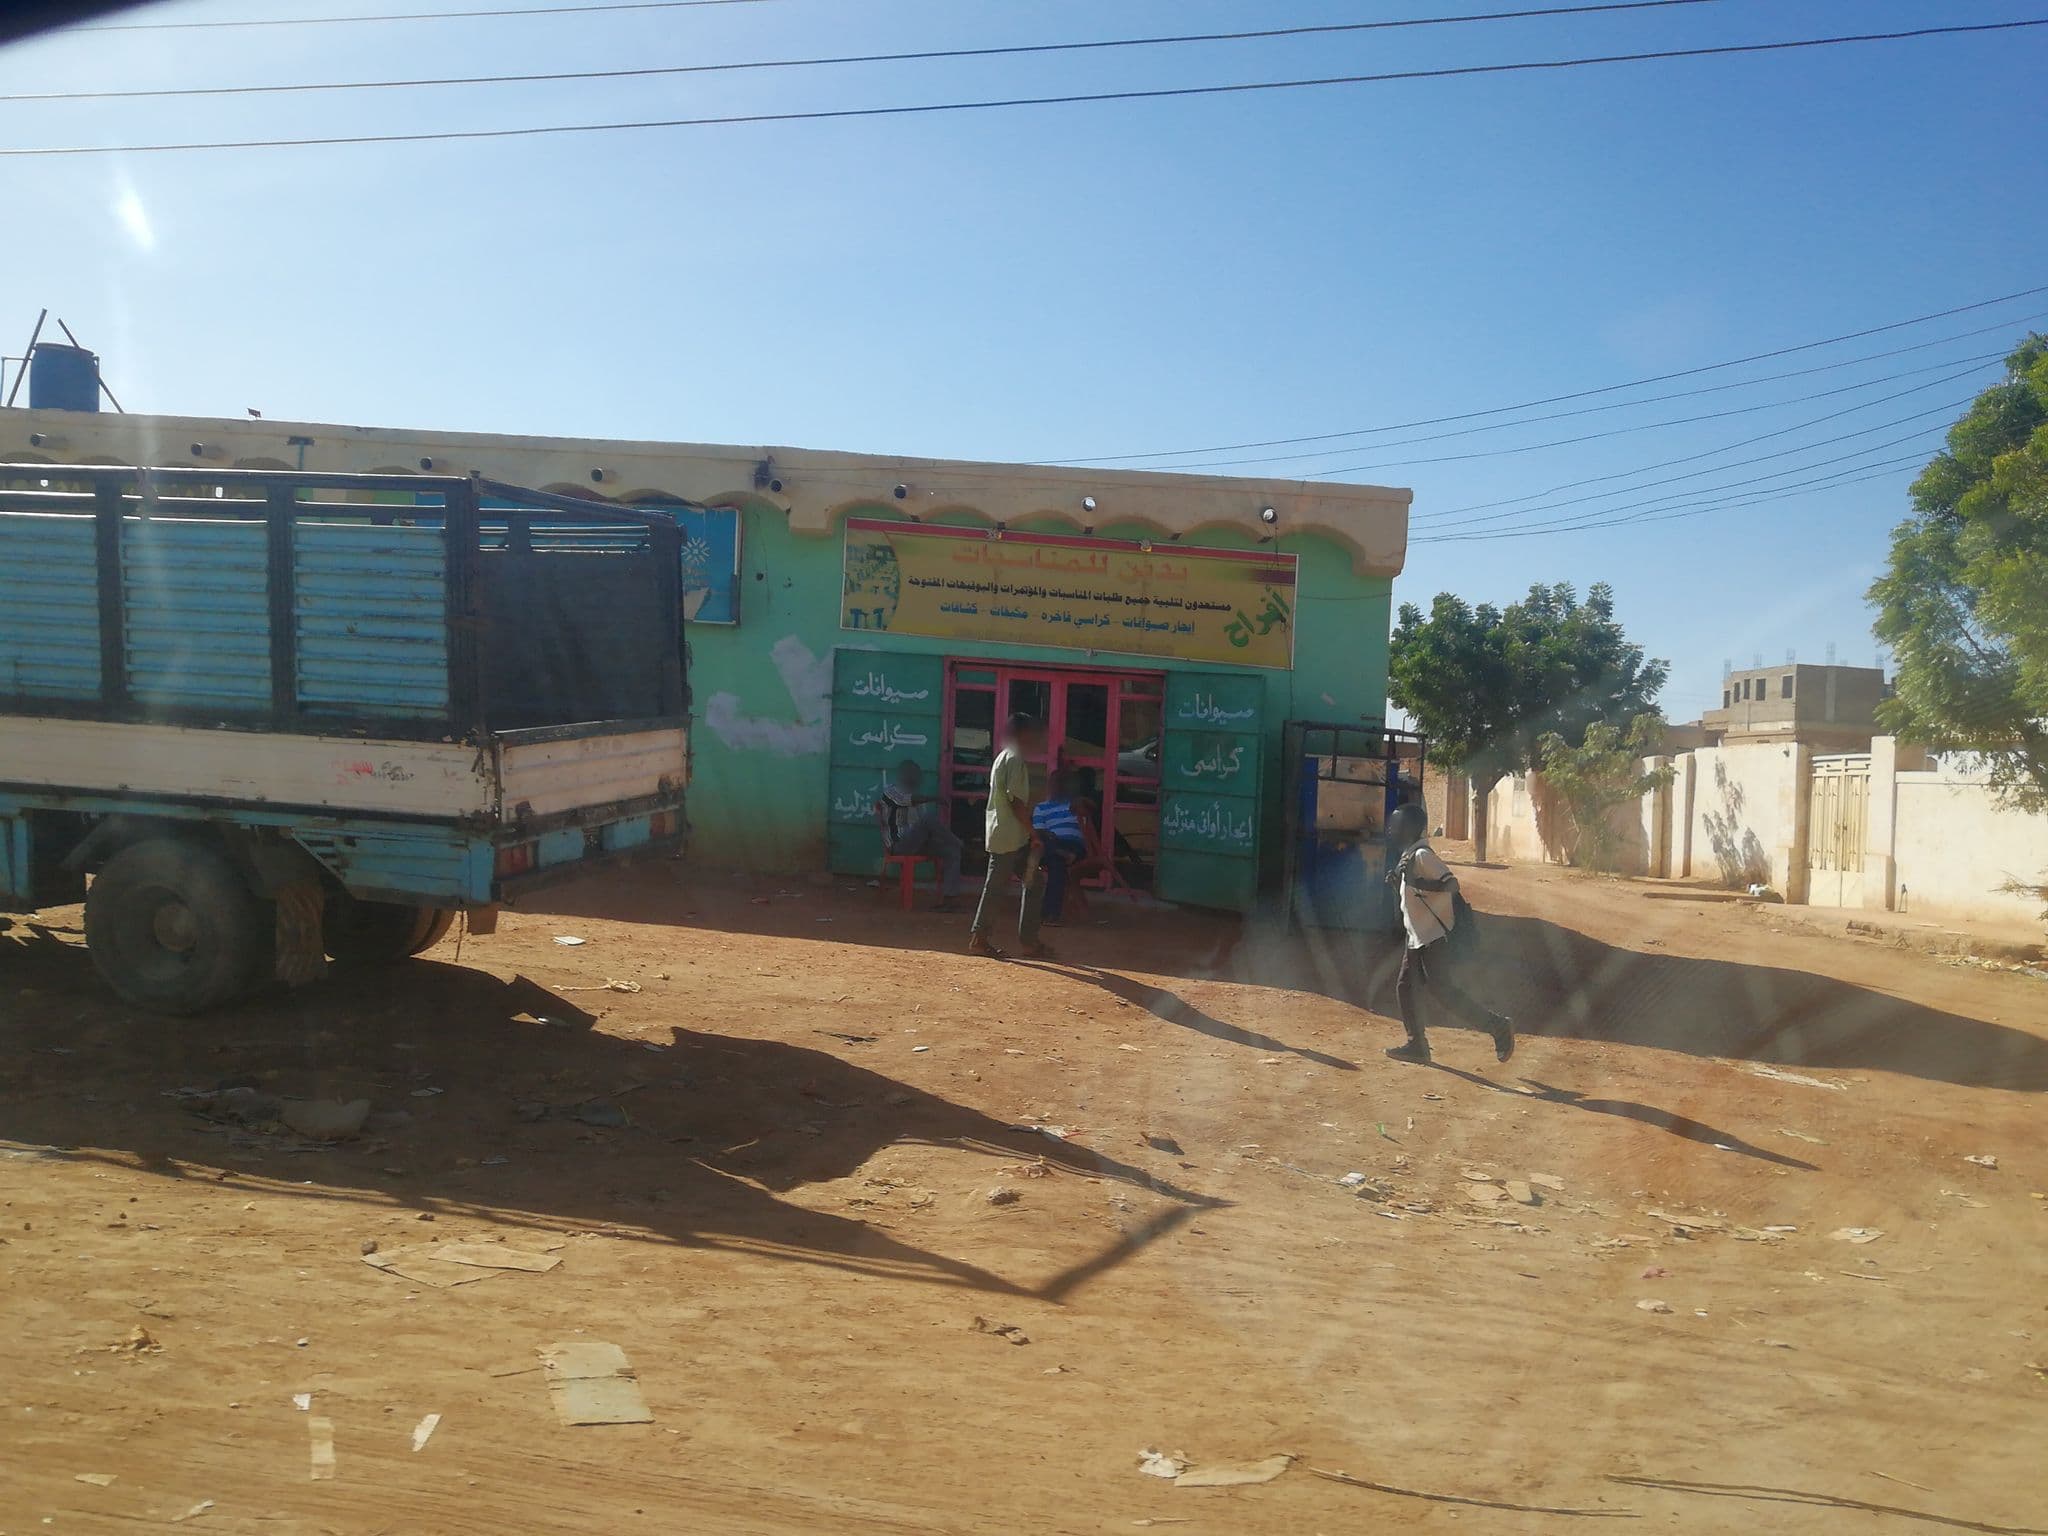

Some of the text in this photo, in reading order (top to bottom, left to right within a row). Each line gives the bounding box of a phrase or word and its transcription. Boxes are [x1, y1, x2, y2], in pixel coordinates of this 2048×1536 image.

[951, 542, 1109, 576] للمناسبات
[1049, 587, 1091, 601] المناسبات
[1093, 591, 1123, 604] طلبات
[1124, 595, 1151, 606] جميع
[1152, 595, 1183, 608] لتلبية
[1184, 598, 1232, 612] مستعدون
[852, 671, 929, 704] صيوانات
[1178, 693, 1255, 725] صيوانات
